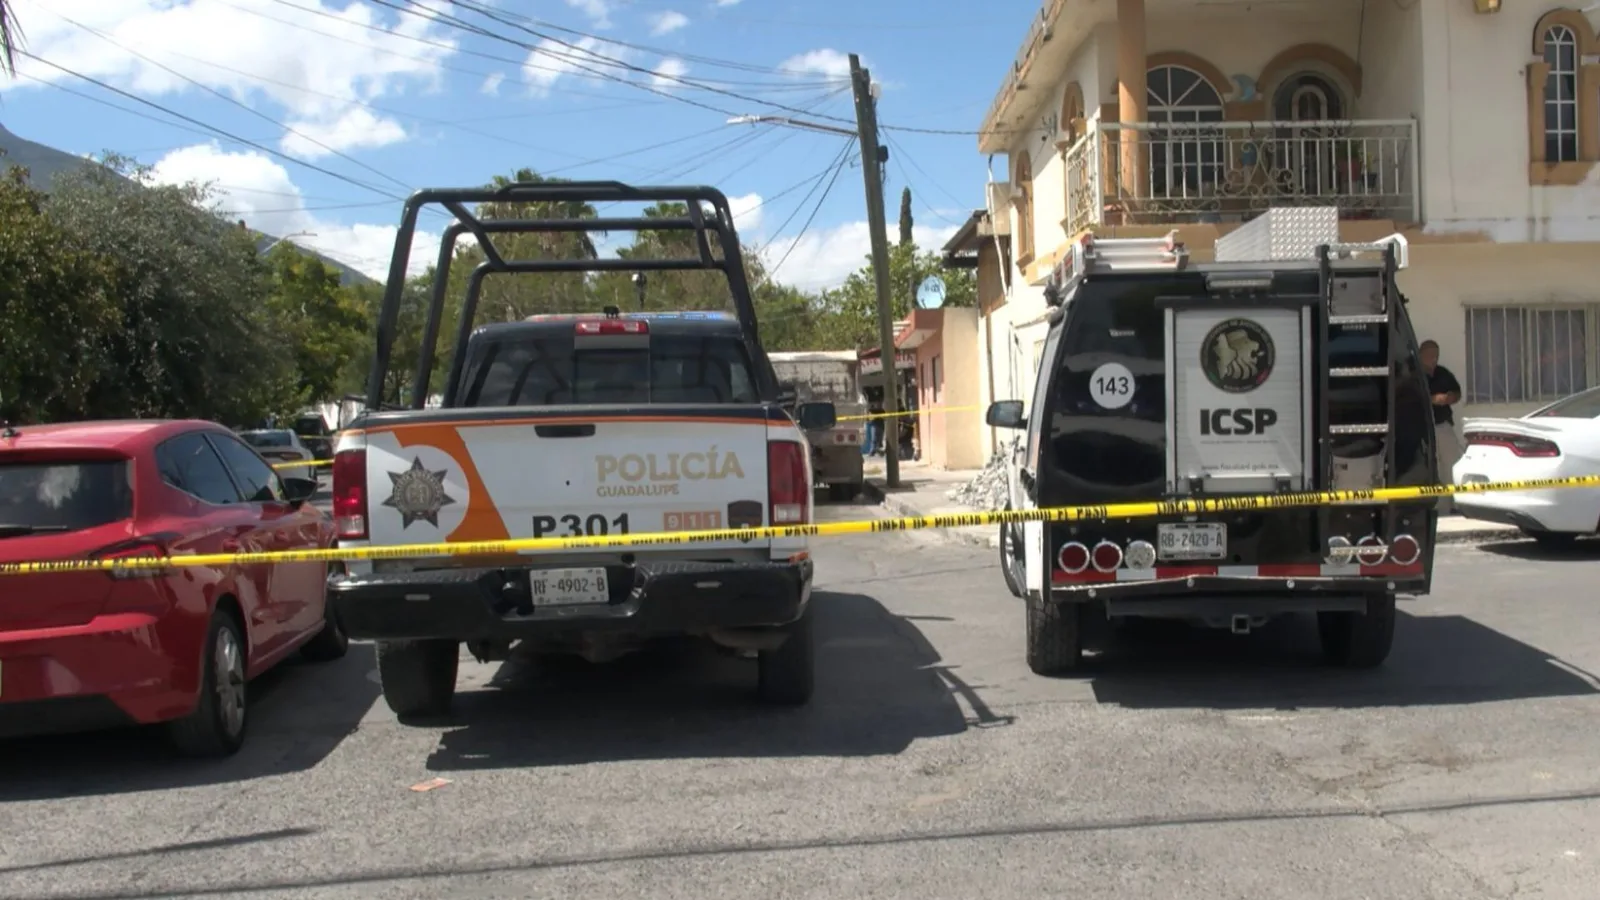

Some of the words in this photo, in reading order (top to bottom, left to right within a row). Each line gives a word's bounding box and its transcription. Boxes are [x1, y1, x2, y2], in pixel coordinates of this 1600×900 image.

[1096, 376, 1129, 395] 143
[1200, 408, 1278, 435] ICSP
[595, 444, 745, 482] POLICÍA
[596, 484, 680, 497] GUADALUPE
[532, 512, 630, 539] P301
[667, 514, 717, 529] 911
[1161, 531, 1223, 548] RB-2420-A
[533, 576, 606, 595] RF-4902-B
